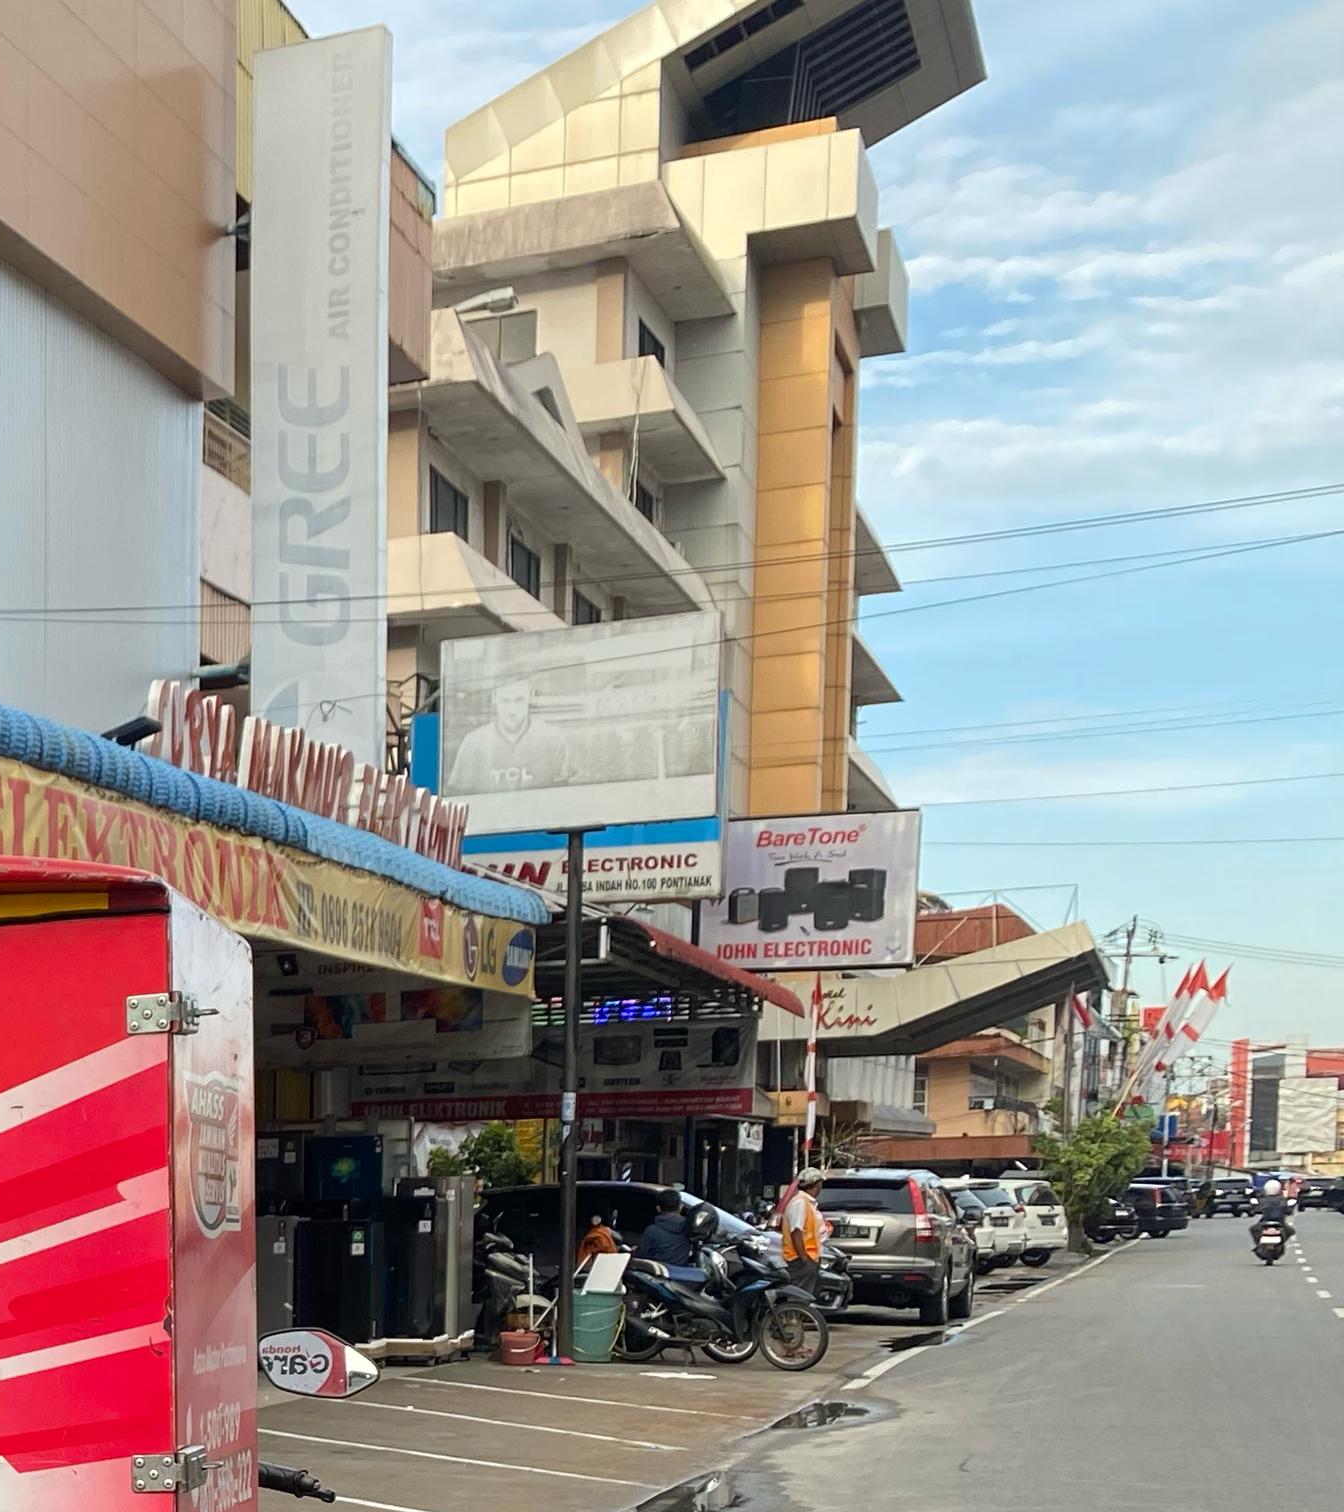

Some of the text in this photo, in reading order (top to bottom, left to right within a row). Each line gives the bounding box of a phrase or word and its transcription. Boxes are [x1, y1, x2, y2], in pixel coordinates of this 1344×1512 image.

[326, 50, 355, 342] AIR CONDITIONER
[278, 362, 352, 648] GREE
[490, 766, 534, 782] TCL
[756, 826, 861, 849] BareTone
[562, 852, 699, 875] EECTRONIC
[595, 880, 623, 892] INDAH
[660, 875, 713, 890] PONTIANAK
[763, 938, 873, 958] ELECTRONIC
[191, 1087, 225, 1121] AHASS
